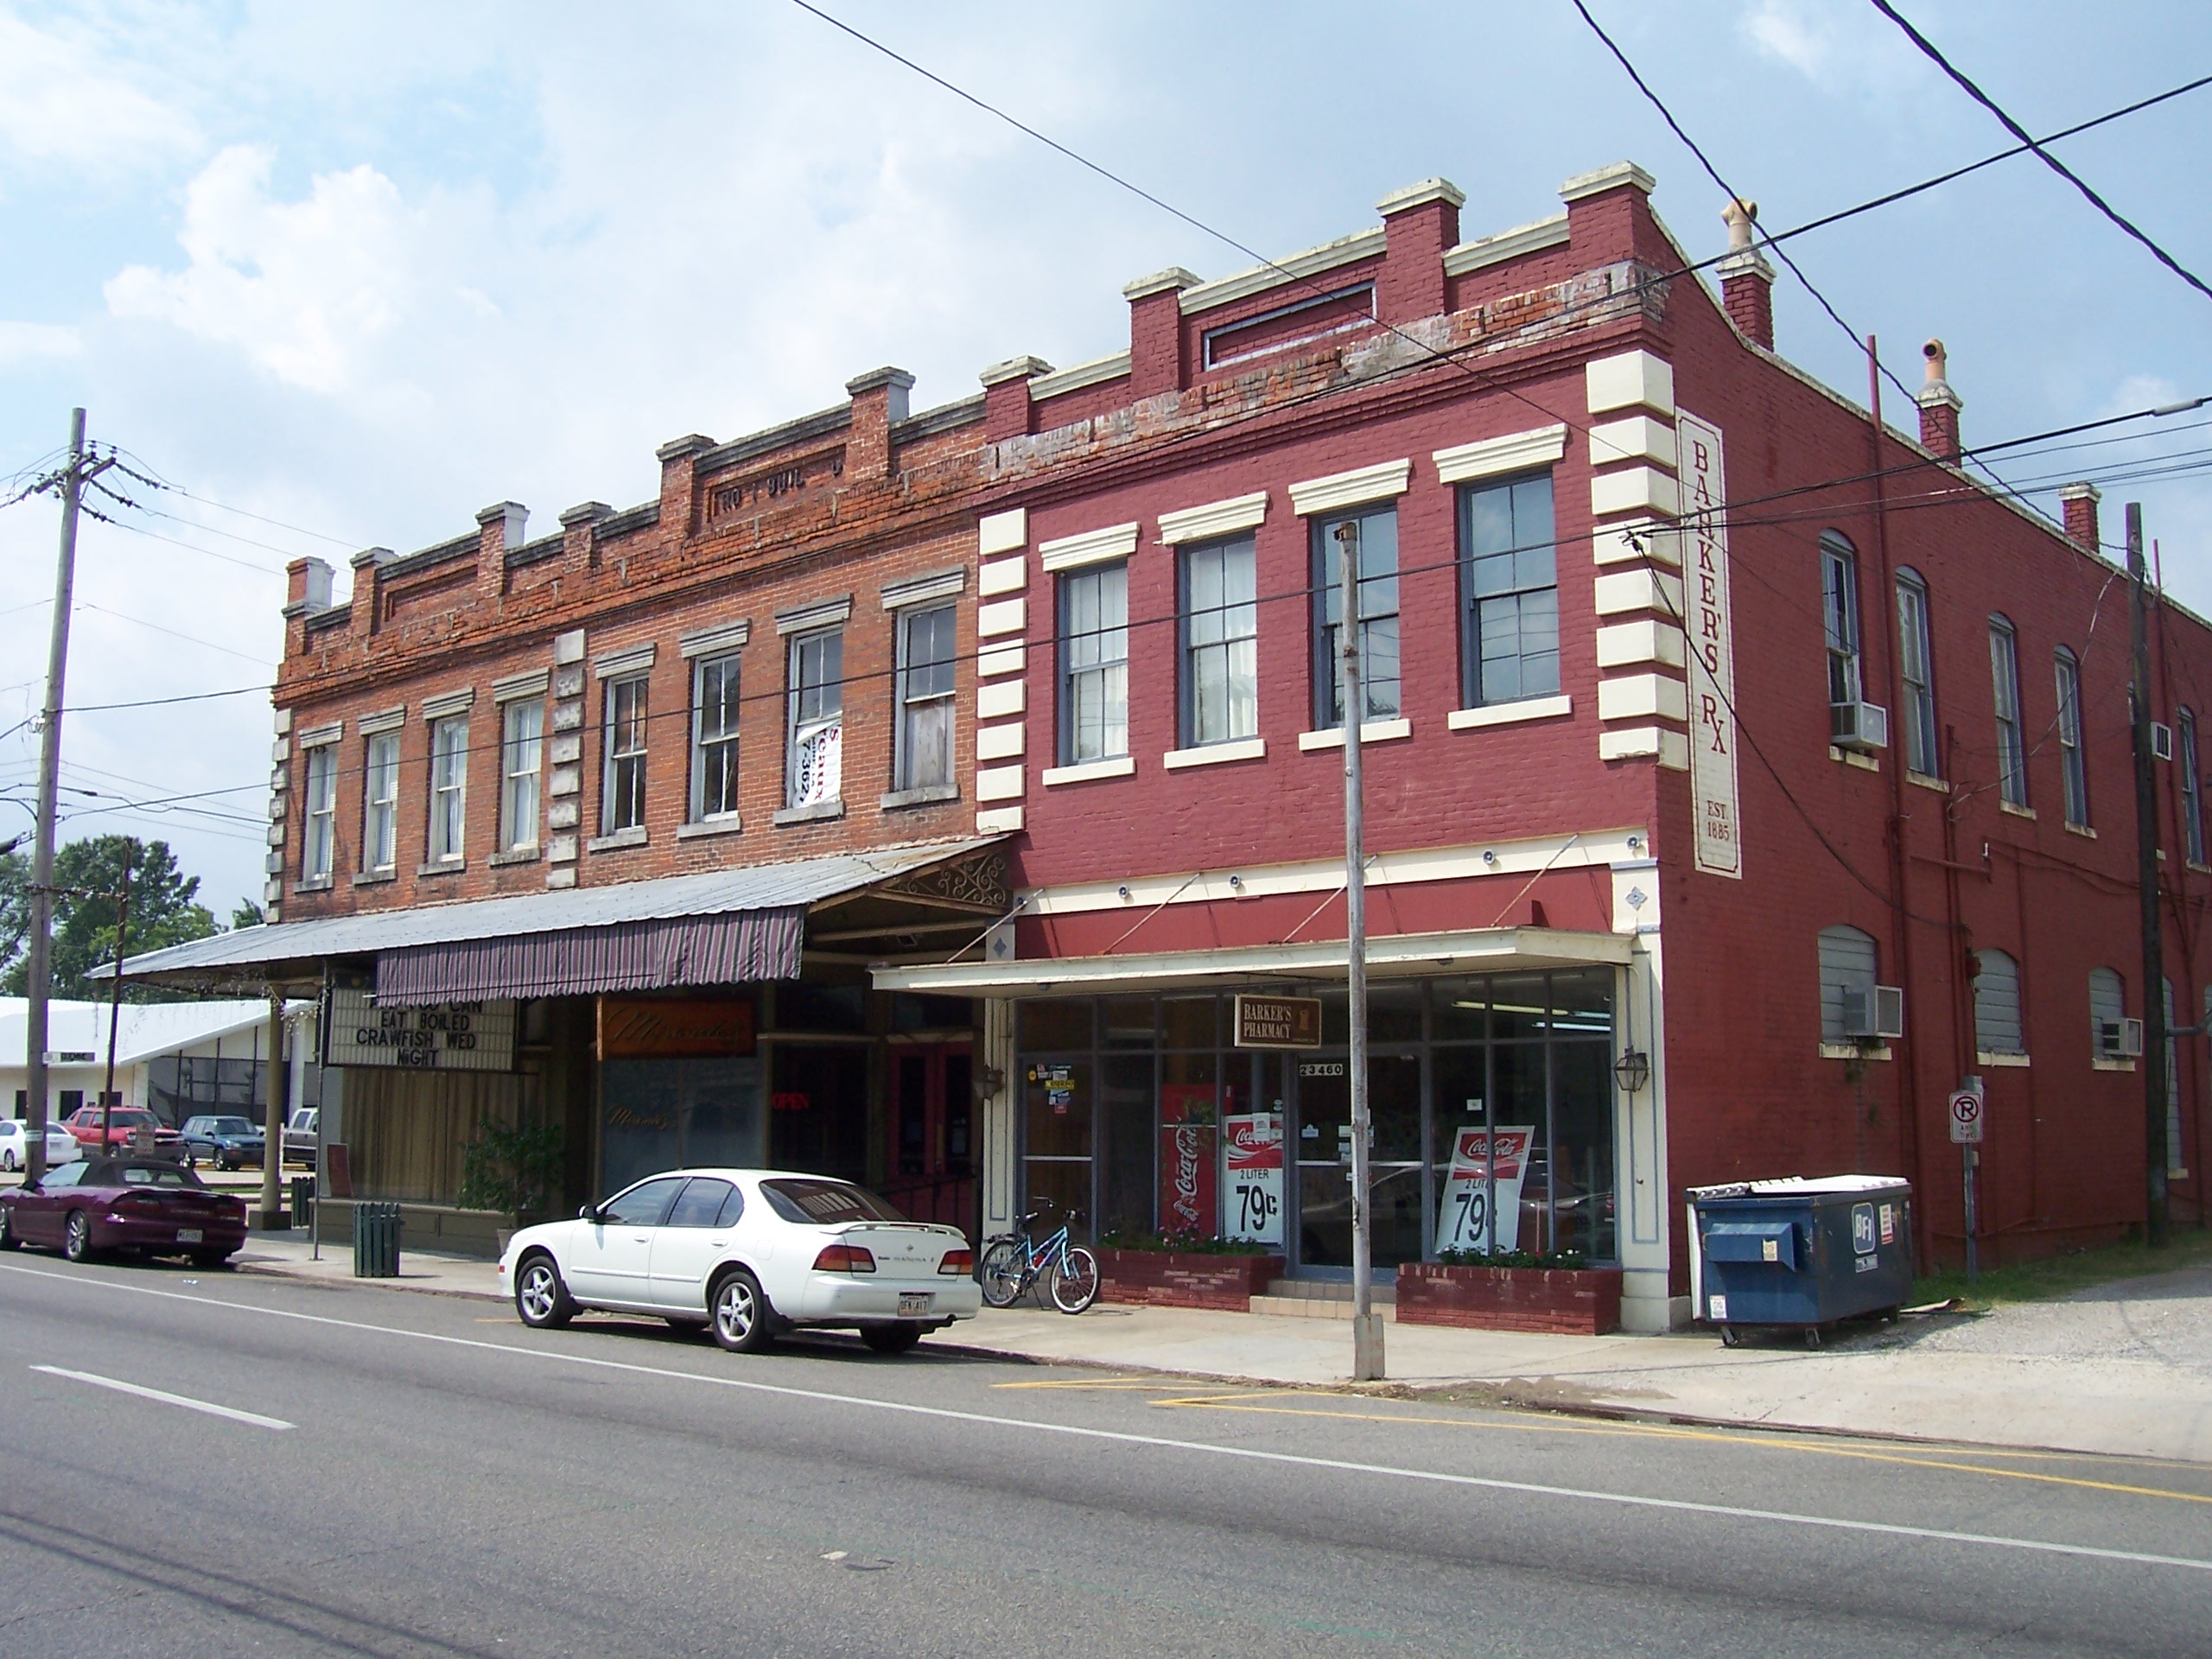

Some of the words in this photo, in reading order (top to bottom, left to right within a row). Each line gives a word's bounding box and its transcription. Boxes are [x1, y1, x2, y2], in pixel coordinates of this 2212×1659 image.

[1692, 439, 1722, 675] BARKER'S
[1707, 821, 1730, 841] 1885
[381, 1011, 408, 1028] EAT
[420, 1013, 470, 1031] BOILED
[1243, 1003, 1292, 1022] BARKER'S
[356, 1028, 435, 1048] CRAWFISH
[446, 1033, 475, 1049] WED
[1243, 1021, 1292, 1039] PHARMACY
[397, 1048, 440, 1066] NIGHT
[1300, 1064, 1342, 1075] 23460
[771, 1092, 810, 1110] OPEN
[1240, 1169, 1245, 1179] 2
[1246, 1169, 1269, 1179] LITER
[1465, 1179, 1471, 1189] 2
[1472, 1179, 1498, 1189] LIT
[1454, 1192, 1497, 1243] 79
[1854, 1213, 1872, 1242] BFI
